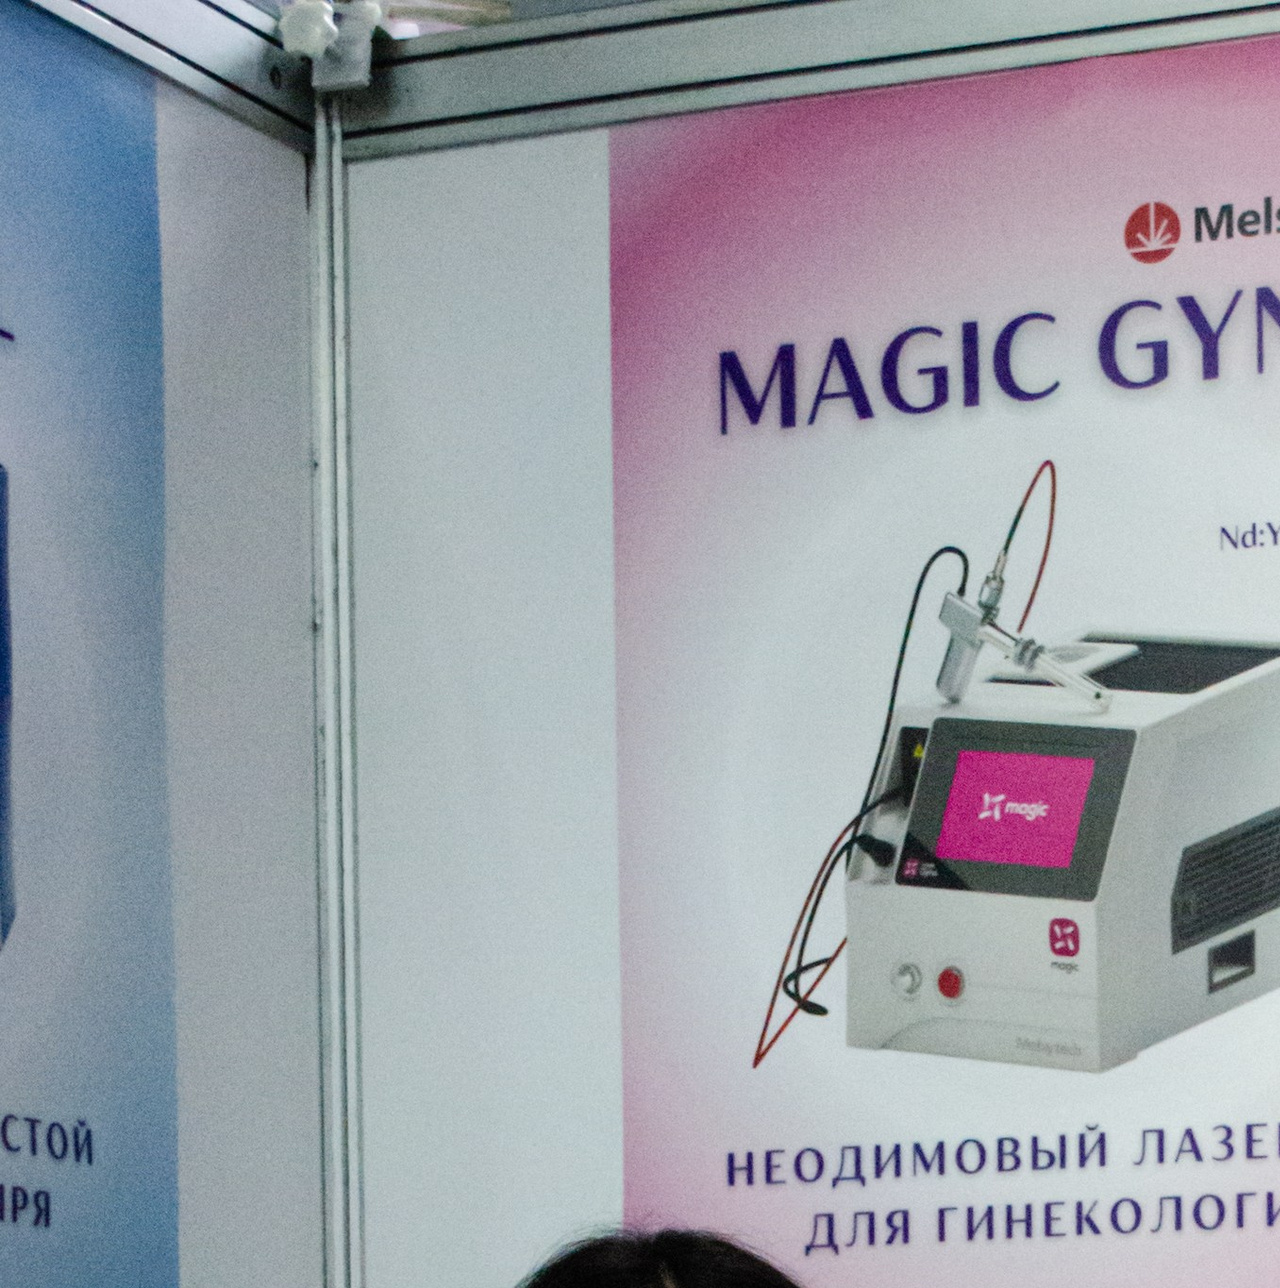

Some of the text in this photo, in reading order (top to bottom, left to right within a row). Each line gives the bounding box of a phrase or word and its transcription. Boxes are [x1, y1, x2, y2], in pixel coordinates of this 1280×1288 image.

[720, 310, 1060, 435] MAGIC
[1005, 801, 1050, 821] magic
[1, 1114, 93, 1166] СТОЙ
[726, 1125, 1109, 1188] НЕОДИМОВЫЙ
[0, 1183, 51, 1228] РЯ
[805, 1210, 911, 1256] ДЛЯ
